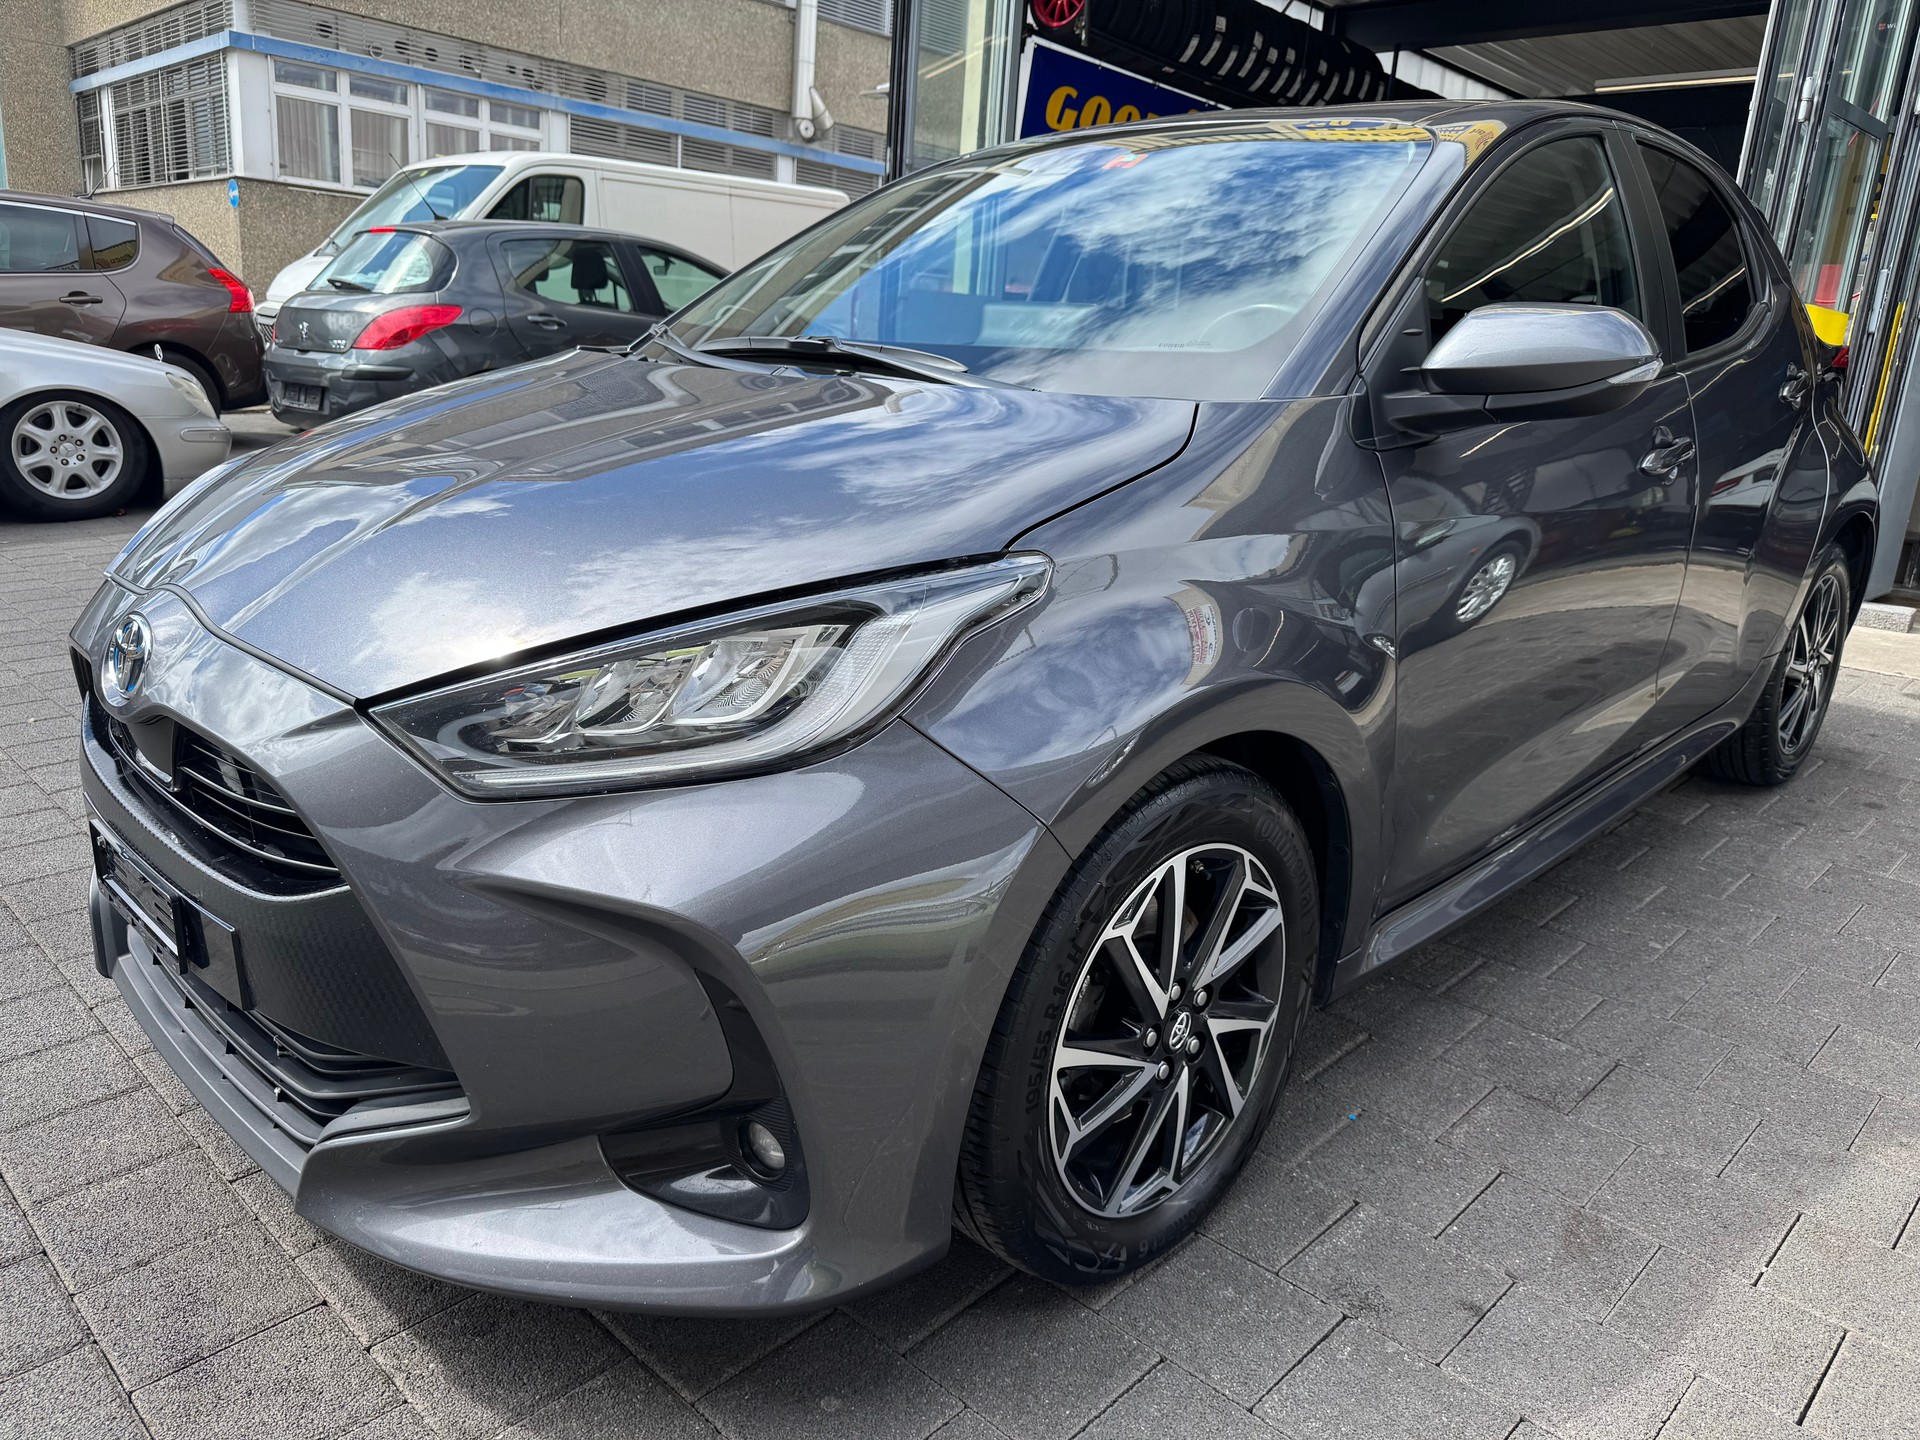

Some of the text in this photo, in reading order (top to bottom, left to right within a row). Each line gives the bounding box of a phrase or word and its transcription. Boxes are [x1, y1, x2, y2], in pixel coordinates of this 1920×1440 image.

[1045, 86, 1160, 131] GO
[1025, 942, 1084, 1114] 195/55 R 16 H
